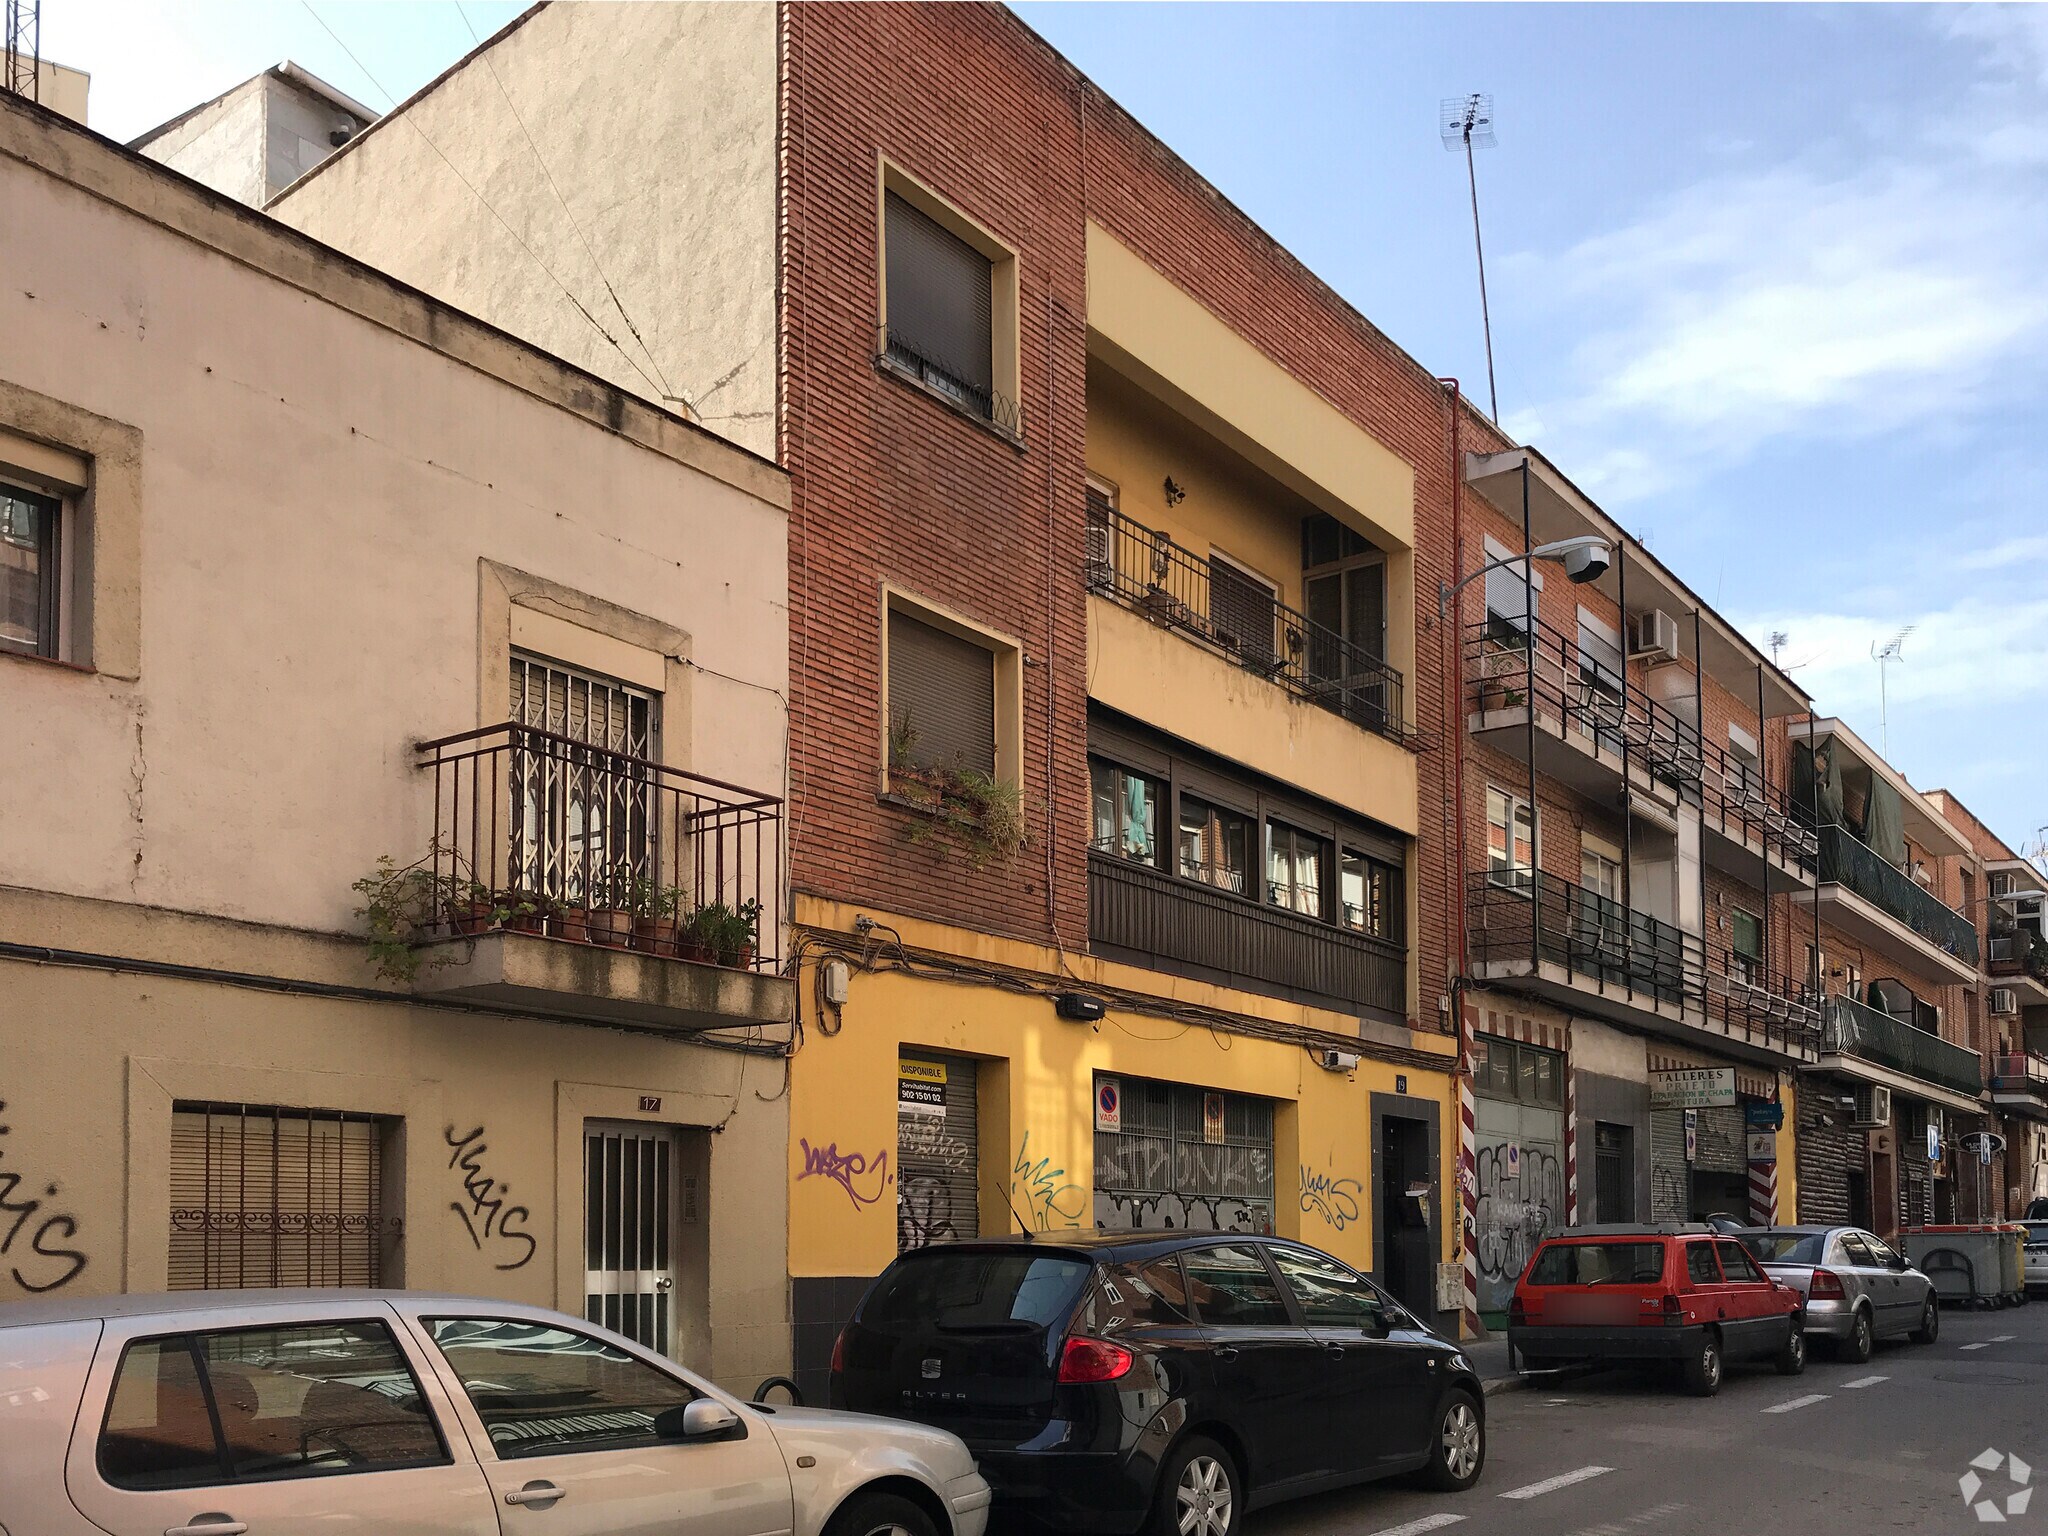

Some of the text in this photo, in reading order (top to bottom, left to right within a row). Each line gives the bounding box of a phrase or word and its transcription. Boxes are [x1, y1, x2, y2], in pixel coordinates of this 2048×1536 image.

[901, 1065, 942, 1078] DISPONIBLE
[1657, 1070, 1724, 1082] TALLERES
[901, 1082, 942, 1093] Servihabitat.com
[1398, 1080, 1405, 1091] 19
[1666, 1081, 1715, 1091] PRIETO
[901, 1090, 942, 1103] 902 15 01 02
[1709, 1088, 1734, 1097] CHAPA
[643, 1097, 658, 1110] 17
[1099, 1113, 1119, 1123] VADO
[902, 1390, 966, 1399] ALTEA
